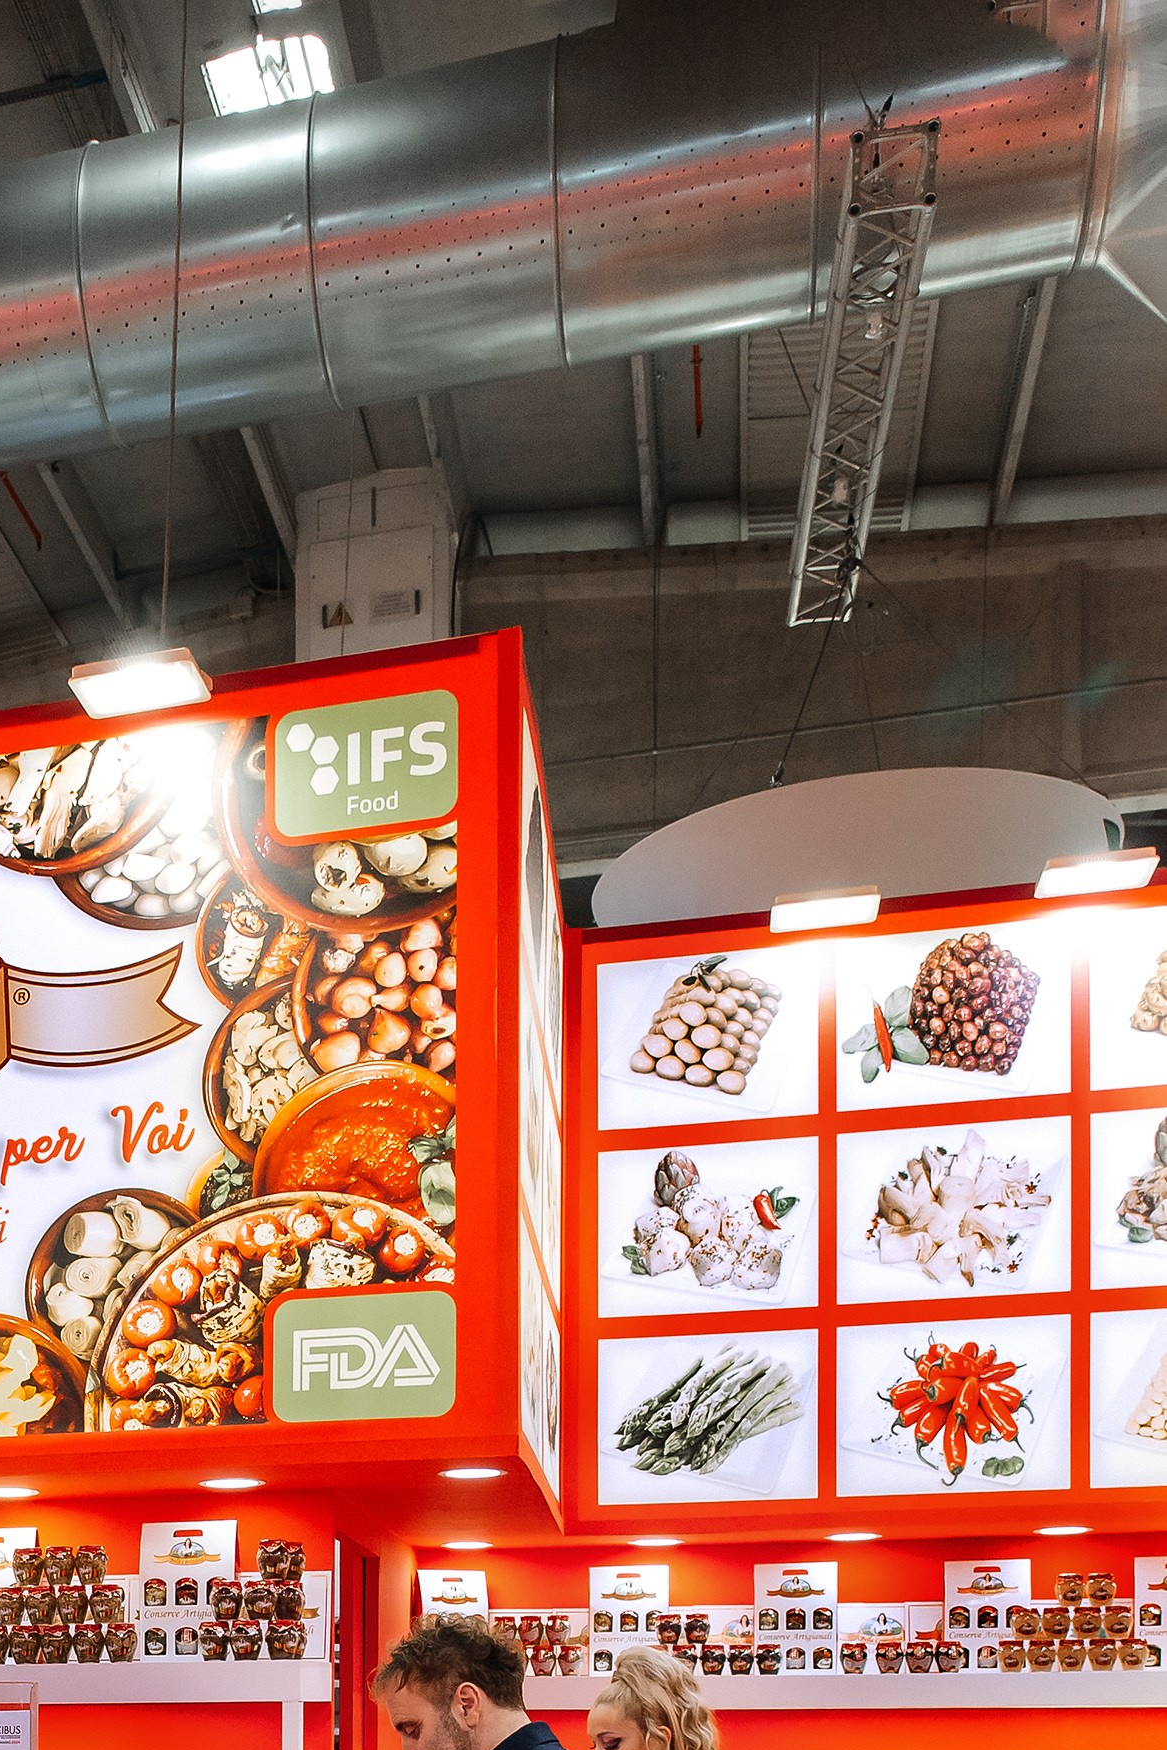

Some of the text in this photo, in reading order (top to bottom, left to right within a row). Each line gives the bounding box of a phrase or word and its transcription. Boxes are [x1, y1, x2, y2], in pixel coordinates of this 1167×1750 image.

[347, 721, 447, 786] IFS
[347, 790, 398, 816] Food
[0, 1126, 85, 1186] per
[111, 1101, 195, 1163] Voi
[292, 1323, 441, 1392] FDA
[144, 1609, 180, 1619] Conserve
